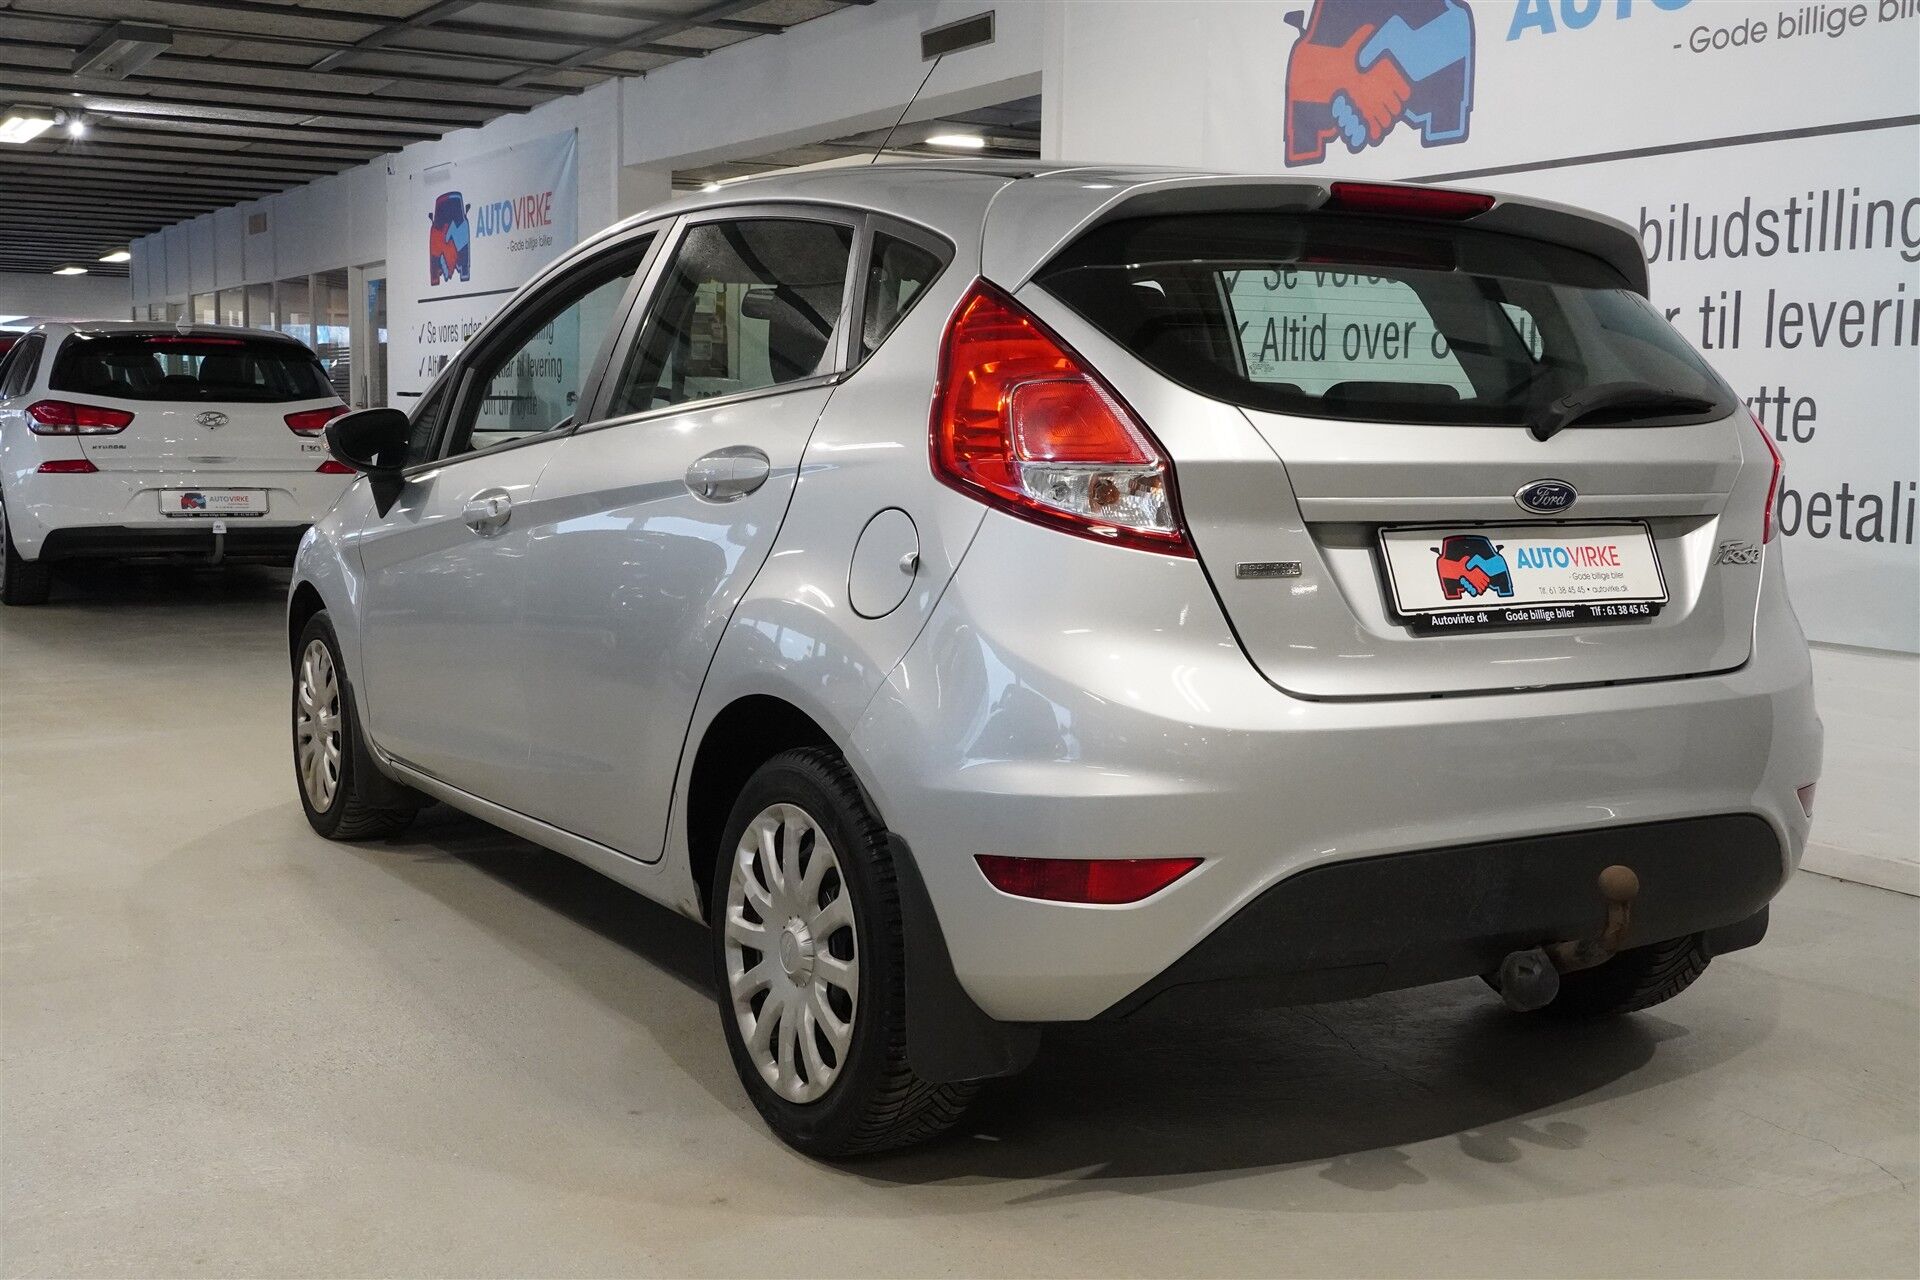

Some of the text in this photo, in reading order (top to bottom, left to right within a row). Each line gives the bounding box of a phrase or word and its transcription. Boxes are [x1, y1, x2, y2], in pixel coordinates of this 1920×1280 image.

[1689, 18, 1768, 54] Gode
[1777, 4, 1867, 39] billige
[476, 191, 552, 238] AUTOVIRKE
[1638, 187, 1920, 264] biludstilling
[427, 321, 436, 344] Se
[438, 323, 459, 343] vores
[1699, 290, 1742, 349] til
[1260, 313, 1327, 362] Altid
[1343, 321, 1416, 361] over
[527, 352, 562, 384] levering
[1746, 386, 1817, 443] tte
[209, 495, 250, 503] AUTOVIRKE
[1531, 486, 1568, 506] Ford
[1517, 545, 1621, 569] AUTOVIRKE
[1549, 586, 1557, 595] 61
[1431, 613, 1475, 626] Autovirke
[1477, 612, 1489, 623] dk
[1505, 610, 1529, 621] Gode
[1530, 608, 1556, 621] billige
[1555, 607, 1575, 618] biler
[1590, 605, 1601, 616] Tlf
[1606, 605, 1617, 616] 61
[1618, 605, 1628, 615] 38
[1629, 604, 1639, 614] 45
[1640, 604, 1650, 614] 45
